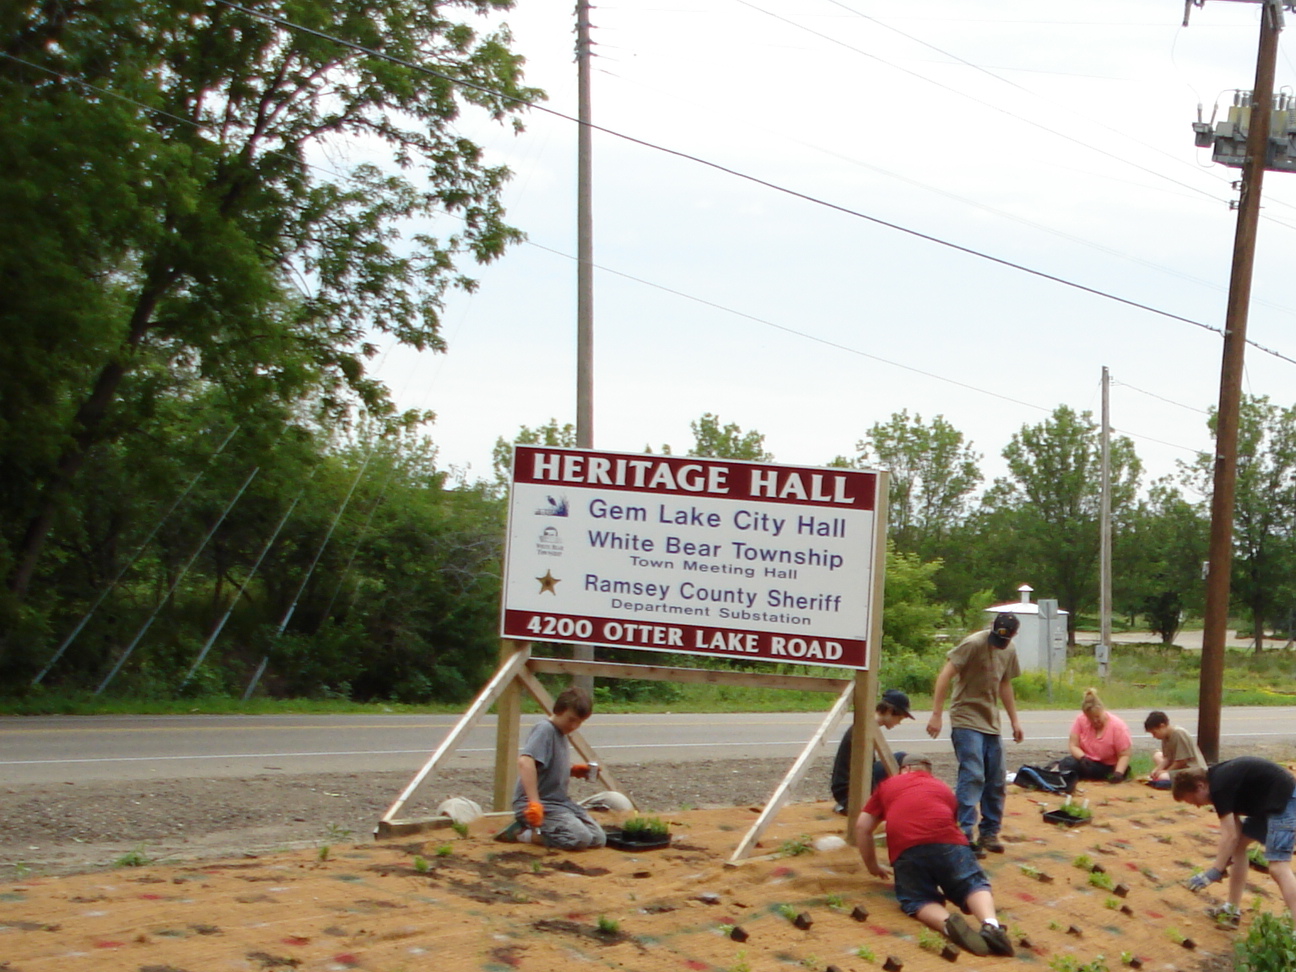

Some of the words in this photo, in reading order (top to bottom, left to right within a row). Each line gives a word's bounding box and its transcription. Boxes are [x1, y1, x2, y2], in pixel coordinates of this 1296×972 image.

[532, 453, 730, 493] HERITAGE
[750, 470, 855, 503] HALL
[588, 499, 647, 521] Gem
[659, 504, 721, 527] Lake
[733, 511, 786, 537] City
[797, 515, 846, 538] Hall
[588, 530, 654, 552] White
[666, 537, 722, 559] Bear
[732, 542, 844, 569] Township
[629, 556, 675, 570] Town
[683, 561, 755, 578] Meeting
[764, 567, 797, 579] Hall
[585, 574, 669, 600] Ramsey
[679, 583, 757, 608] County
[767, 589, 842, 612] Sheriff
[611, 599, 710, 617] Department
[719, 608, 811, 625] Substation
[527, 615, 592, 639] 4200
[603, 622, 683, 646] OTTER
[695, 630, 759, 653] LAKE
[771, 637, 843, 661] ROAD
